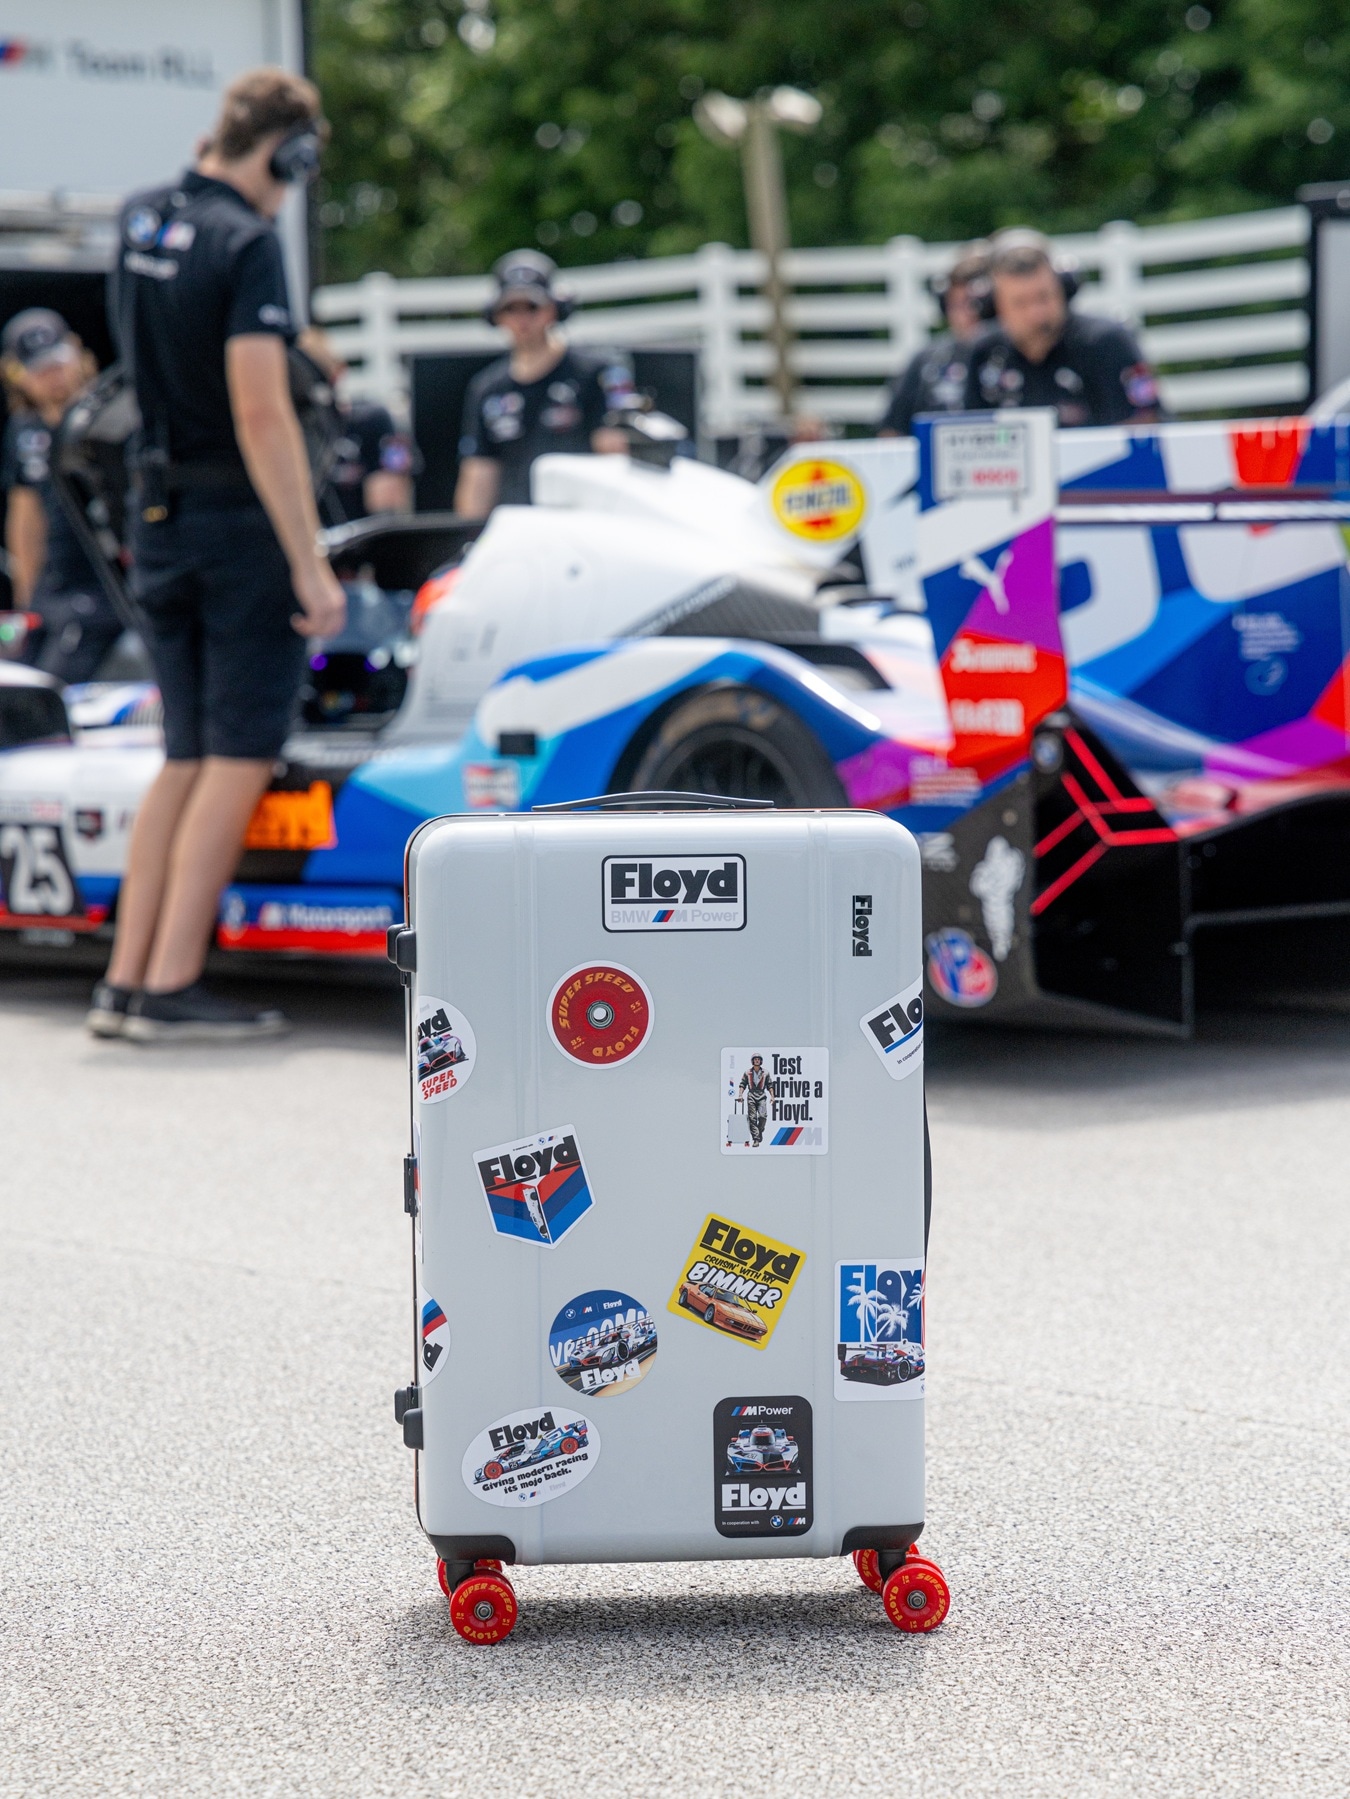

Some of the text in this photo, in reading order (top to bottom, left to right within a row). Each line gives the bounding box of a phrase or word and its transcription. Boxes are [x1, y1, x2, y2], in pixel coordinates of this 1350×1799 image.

[1, 824, 75, 917] 25
[611, 862, 738, 905] Floyd
[611, 910, 650, 923] BMW
[691, 909, 739, 922] Power
[852, 895, 873, 957] Floyd
[558, 972, 635, 1029] SUPER SPEED
[867, 990, 923, 1049] Flo
[592, 1025, 640, 1057] FLOYD
[772, 1053, 802, 1075] Test
[421, 1069, 454, 1092] SUPER
[423, 1078, 458, 1100] SPEED
[772, 1077, 823, 1098] drive a
[772, 1100, 813, 1124] Floyd.
[478, 1134, 582, 1192] Floyd
[699, 1218, 801, 1284] Floyd
[704, 1254, 776, 1285] CRUISIN' WITH MY
[686, 1261, 783, 1310] BIMMER
[603, 1299, 622, 1310] Floyd
[840, 1264, 923, 1343] Floy
[580, 1359, 642, 1390] Floyd
[758, 1406, 793, 1415] Power
[488, 1411, 556, 1451] Floyd
[482, 1476, 514, 1491] Giving
[517, 1463, 553, 1481] modern
[555, 1452, 589, 1467] racing
[504, 1467, 572, 1494] its mojo back.
[721, 1482, 806, 1511] Floyd
[458, 1582, 513, 1613] SUPER SPEED
[889, 1585, 903, 1622] FLOYD
[916, 1572, 946, 1628] SUPER SPEED
[463, 1625, 499, 1640] FLOYD
